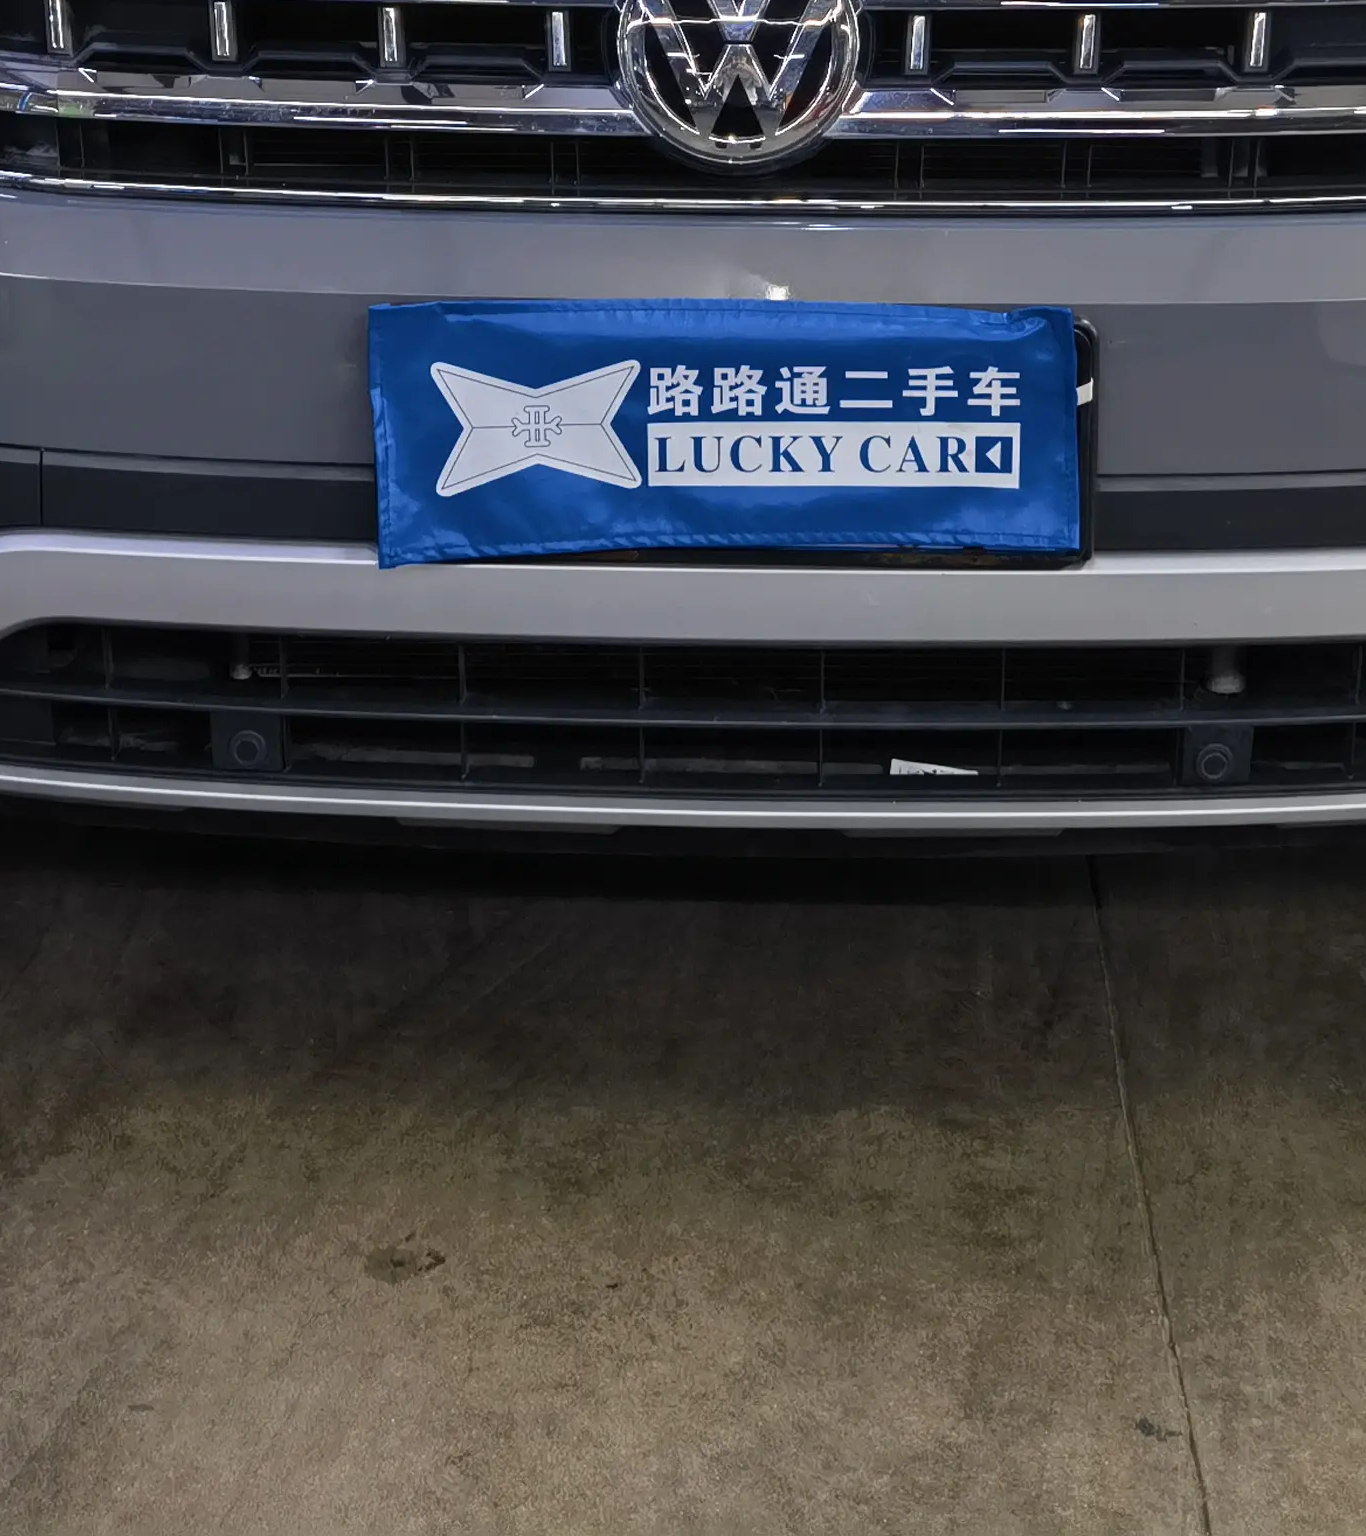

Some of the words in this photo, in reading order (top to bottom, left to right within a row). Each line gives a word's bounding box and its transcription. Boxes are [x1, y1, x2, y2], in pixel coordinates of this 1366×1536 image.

[646, 366, 1023, 417] 路路通二手车
[653, 433, 841, 474] LUCKY
[858, 433, 975, 474] CAR
